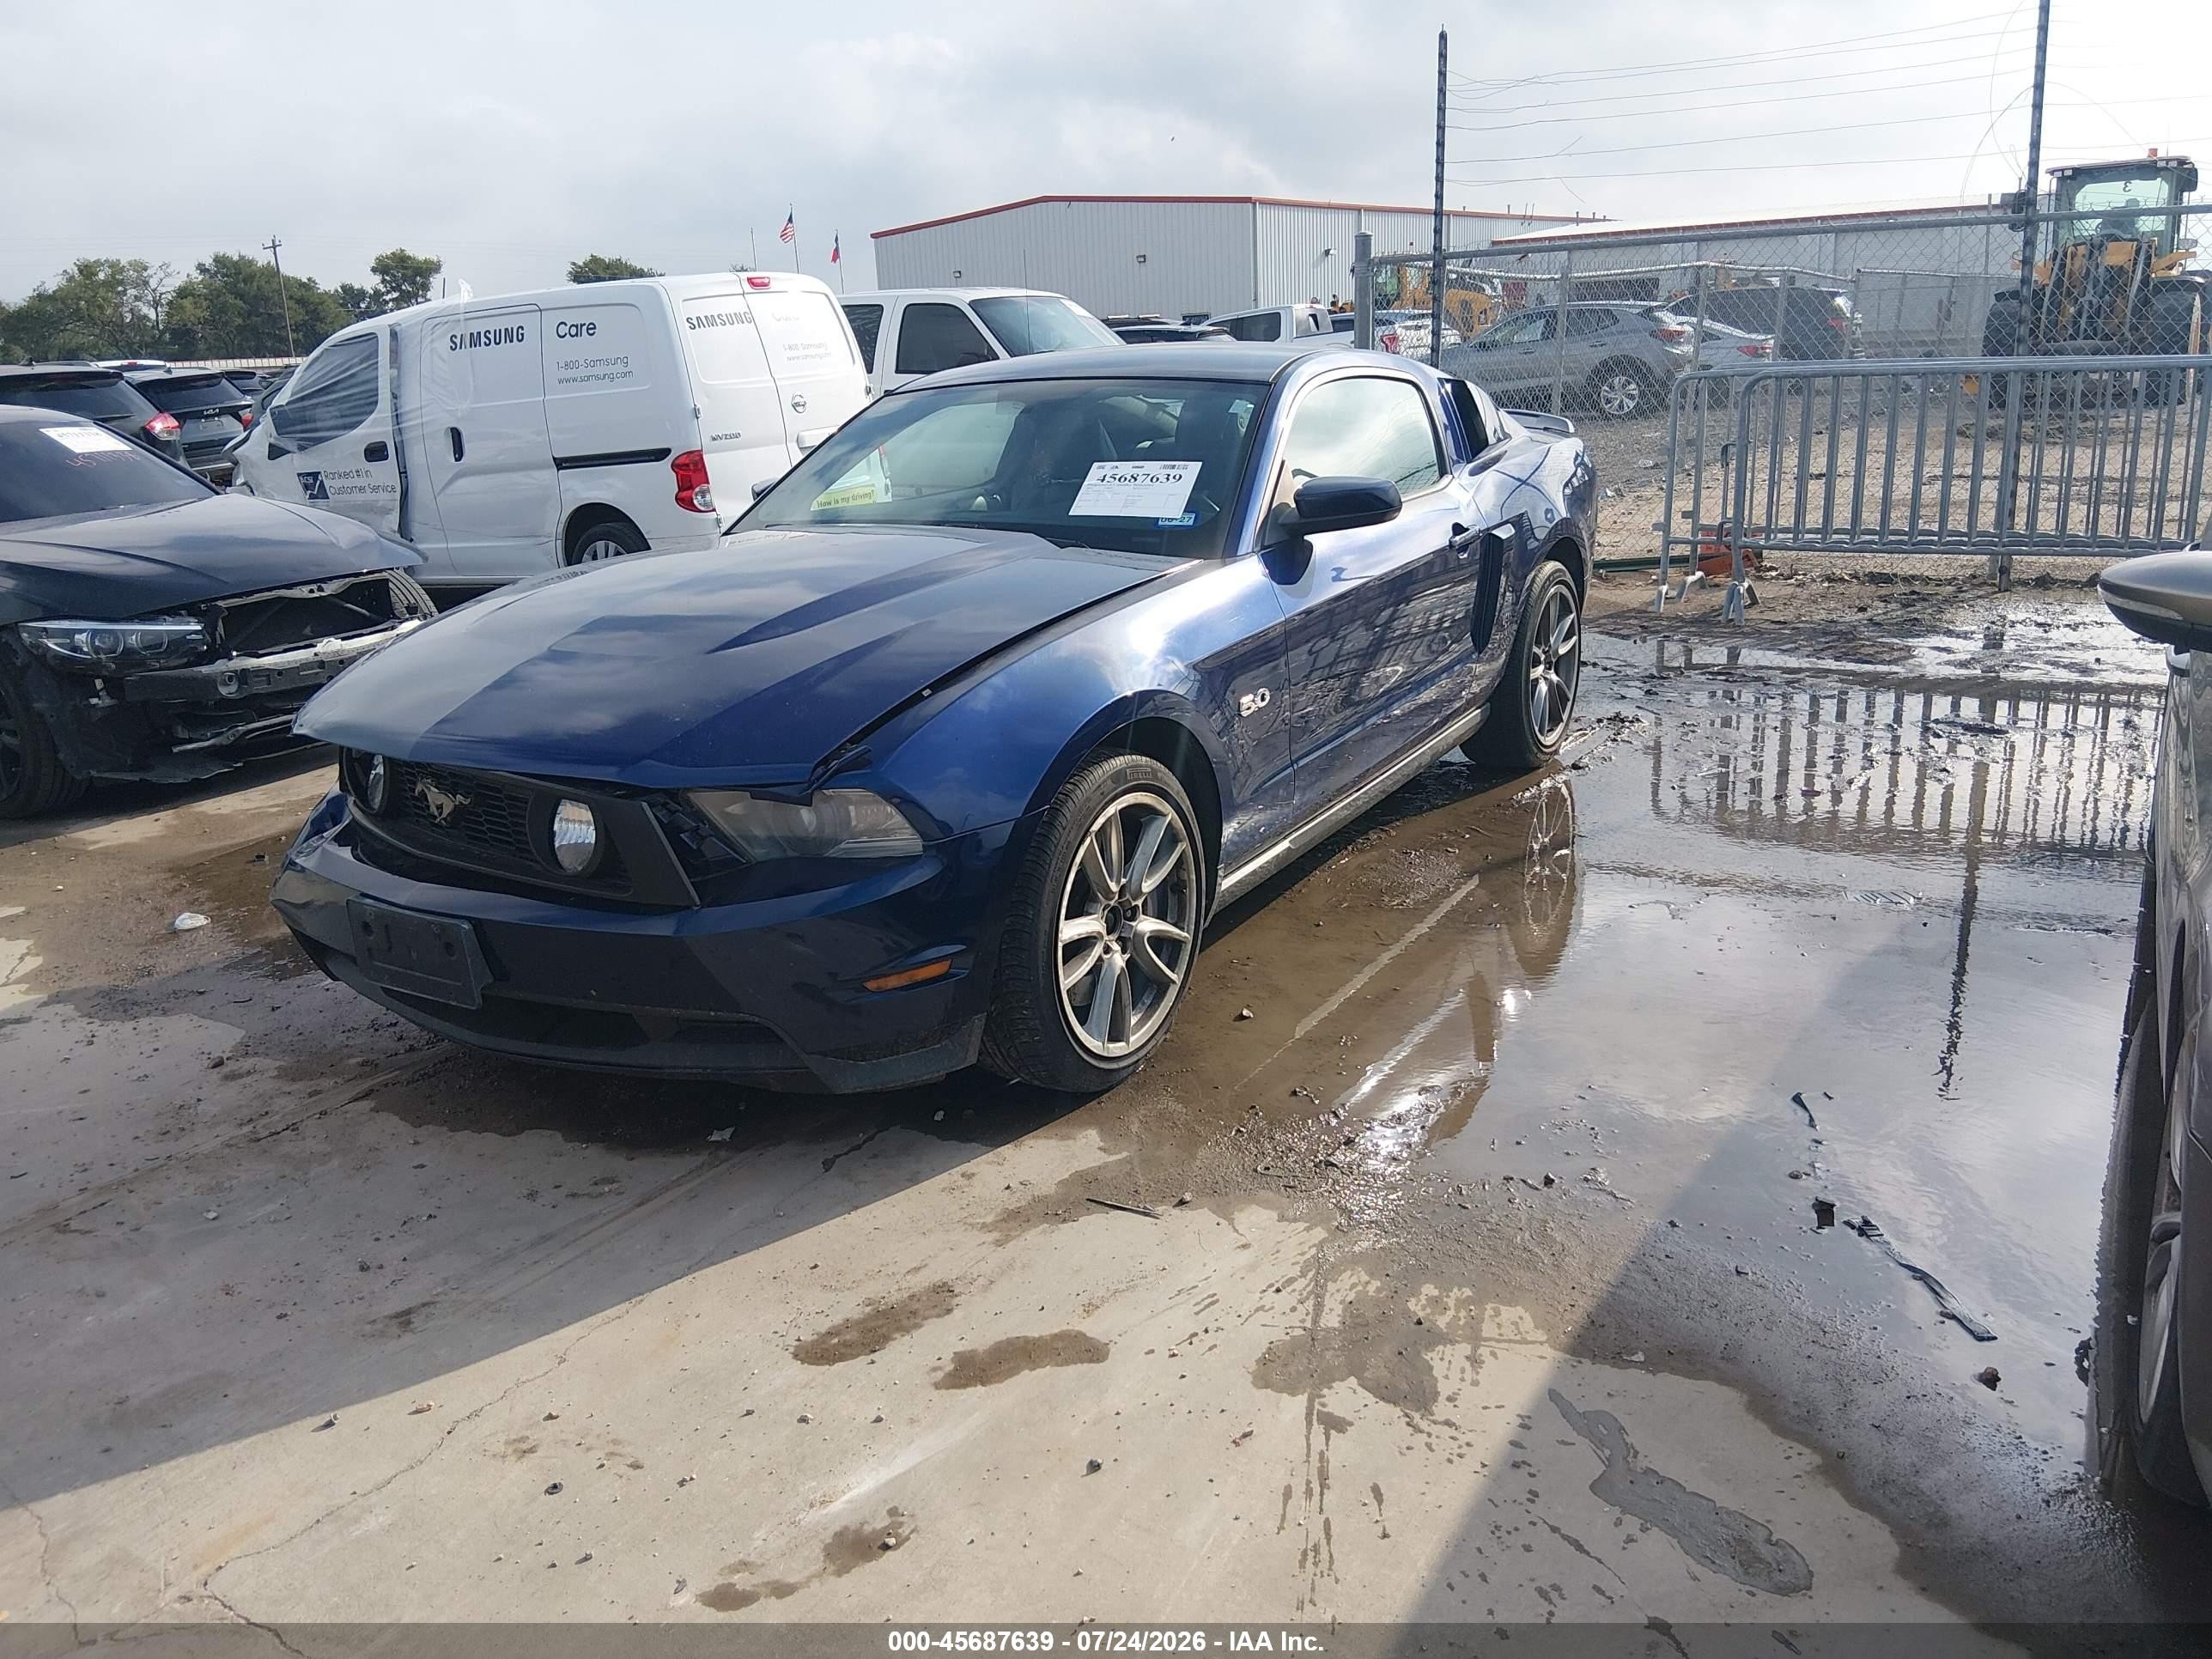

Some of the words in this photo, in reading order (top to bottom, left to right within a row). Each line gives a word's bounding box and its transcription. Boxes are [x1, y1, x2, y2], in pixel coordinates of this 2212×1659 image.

[687, 311, 753, 330] SAMSUNG
[556, 321, 597, 339] Care
[449, 325, 526, 351] SAMSUNG
[556, 356, 629, 371] 1-800-Samsung
[557, 370, 634, 385] www.samsung.com
[323, 470, 355, 480] Ranked
[1096, 473, 1183, 484] 45687639
[329, 484, 367, 495] Customer
[368, 481, 398, 495] Service
[816, 500, 832, 508] How
[851, 489, 874, 501] driving?
